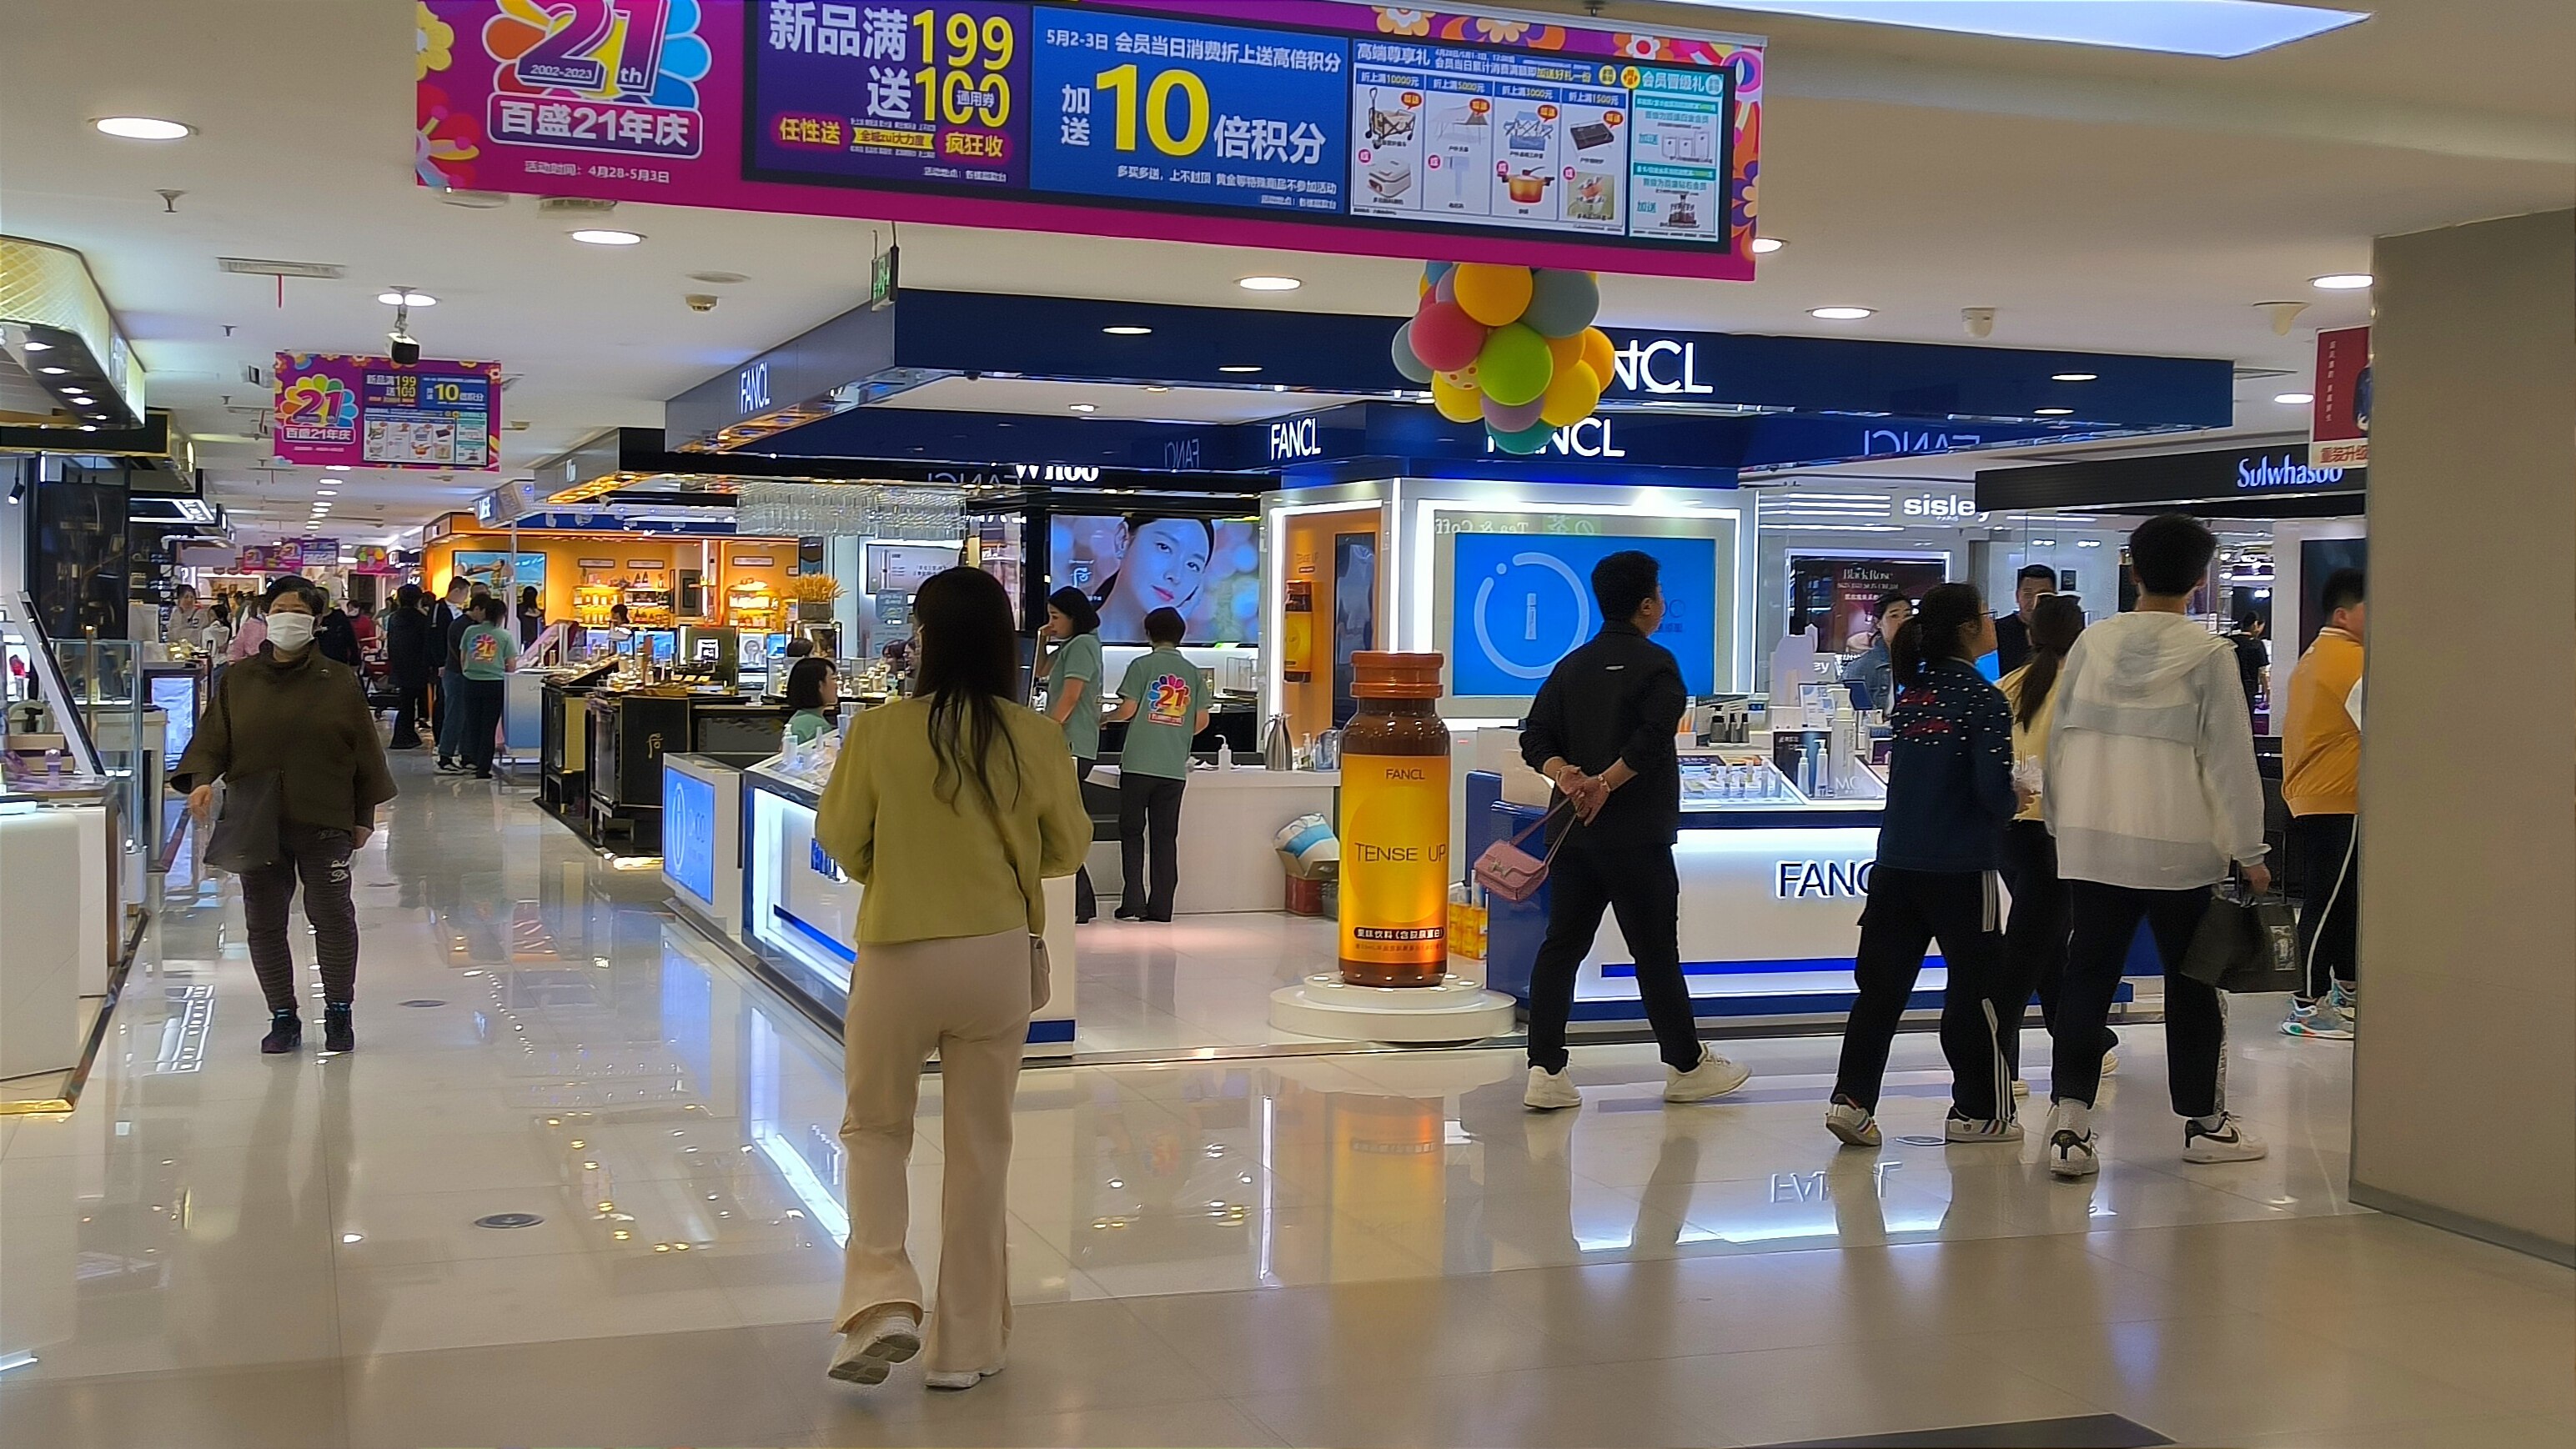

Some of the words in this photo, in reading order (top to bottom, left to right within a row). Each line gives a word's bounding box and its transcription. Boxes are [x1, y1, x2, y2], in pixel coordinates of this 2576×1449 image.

[1046, 28, 1109, 52] 5月2-3日
[1114, 31, 1342, 73] 会员当日消费折上送高倍积分
[530, 64, 593, 81] 2002-2023
[619, 66, 642, 84] th
[500, 99, 691, 148] 百盛21年庆
[778, 117, 841, 147] 任性送
[944, 131, 1005, 158] 疯狂收
[740, 361, 771, 415] FANCL
[1270, 417, 1322, 461] FANCL
[1385, 767, 1426, 781] FANCL
[1354, 842, 1419, 863] TENSE
[1428, 842, 1447, 863] UP
[1778, 862, 1872, 898] FANC
